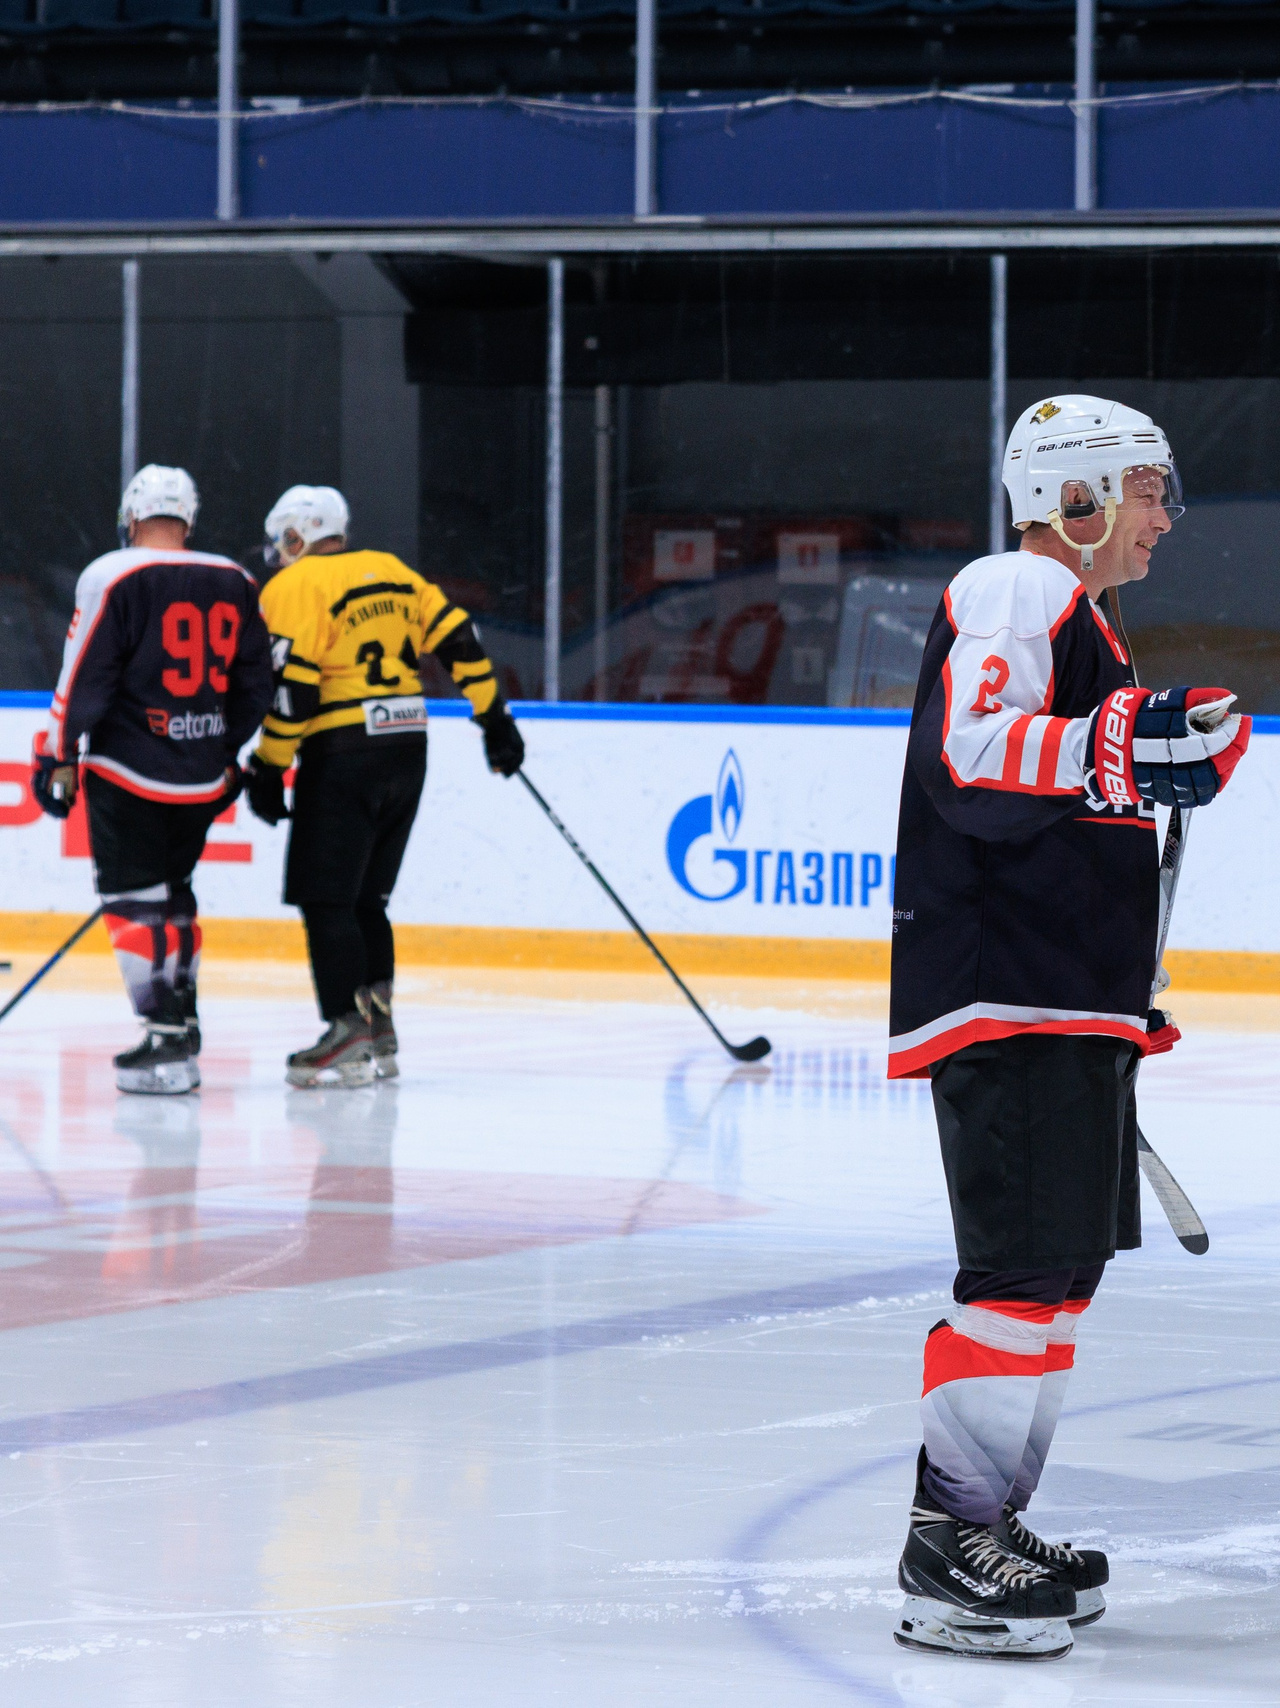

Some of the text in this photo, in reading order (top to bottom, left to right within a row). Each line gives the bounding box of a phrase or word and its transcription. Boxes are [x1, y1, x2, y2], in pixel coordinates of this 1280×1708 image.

[162, 601, 241, 697] 99
[970, 654, 1011, 713] 2
[754, 848, 897, 907] ГАЗПР
[948, 1567, 992, 1598] CCM
